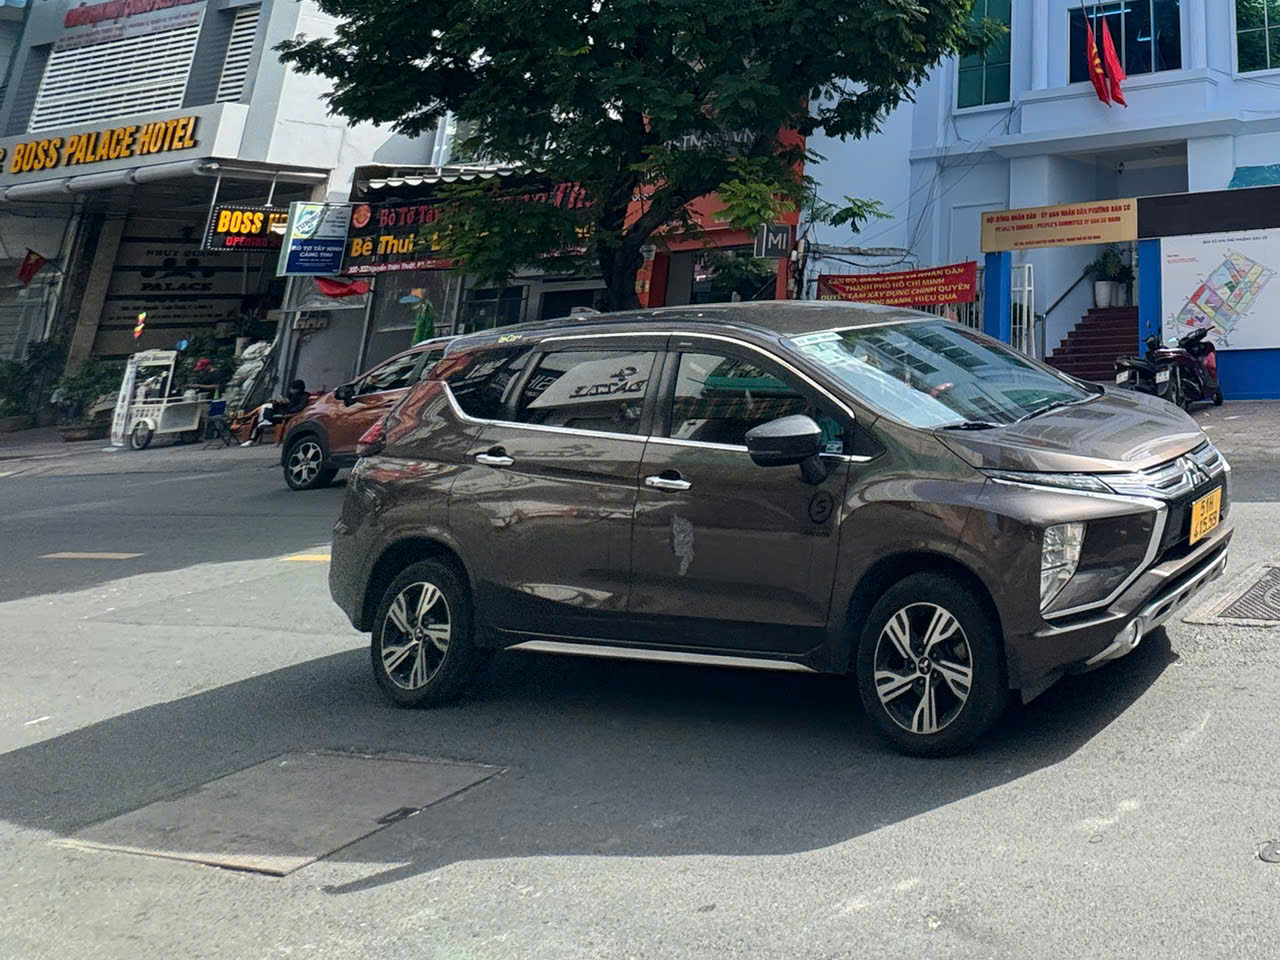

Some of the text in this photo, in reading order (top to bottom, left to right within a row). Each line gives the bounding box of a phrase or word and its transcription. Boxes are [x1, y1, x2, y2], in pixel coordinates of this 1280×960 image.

[9, 116, 199, 174] BOSS PALACE HOTEL
[217, 210, 264, 234] BOSS
[377, 232, 414, 254] Thui
[922, 277, 945, 286] MINH
